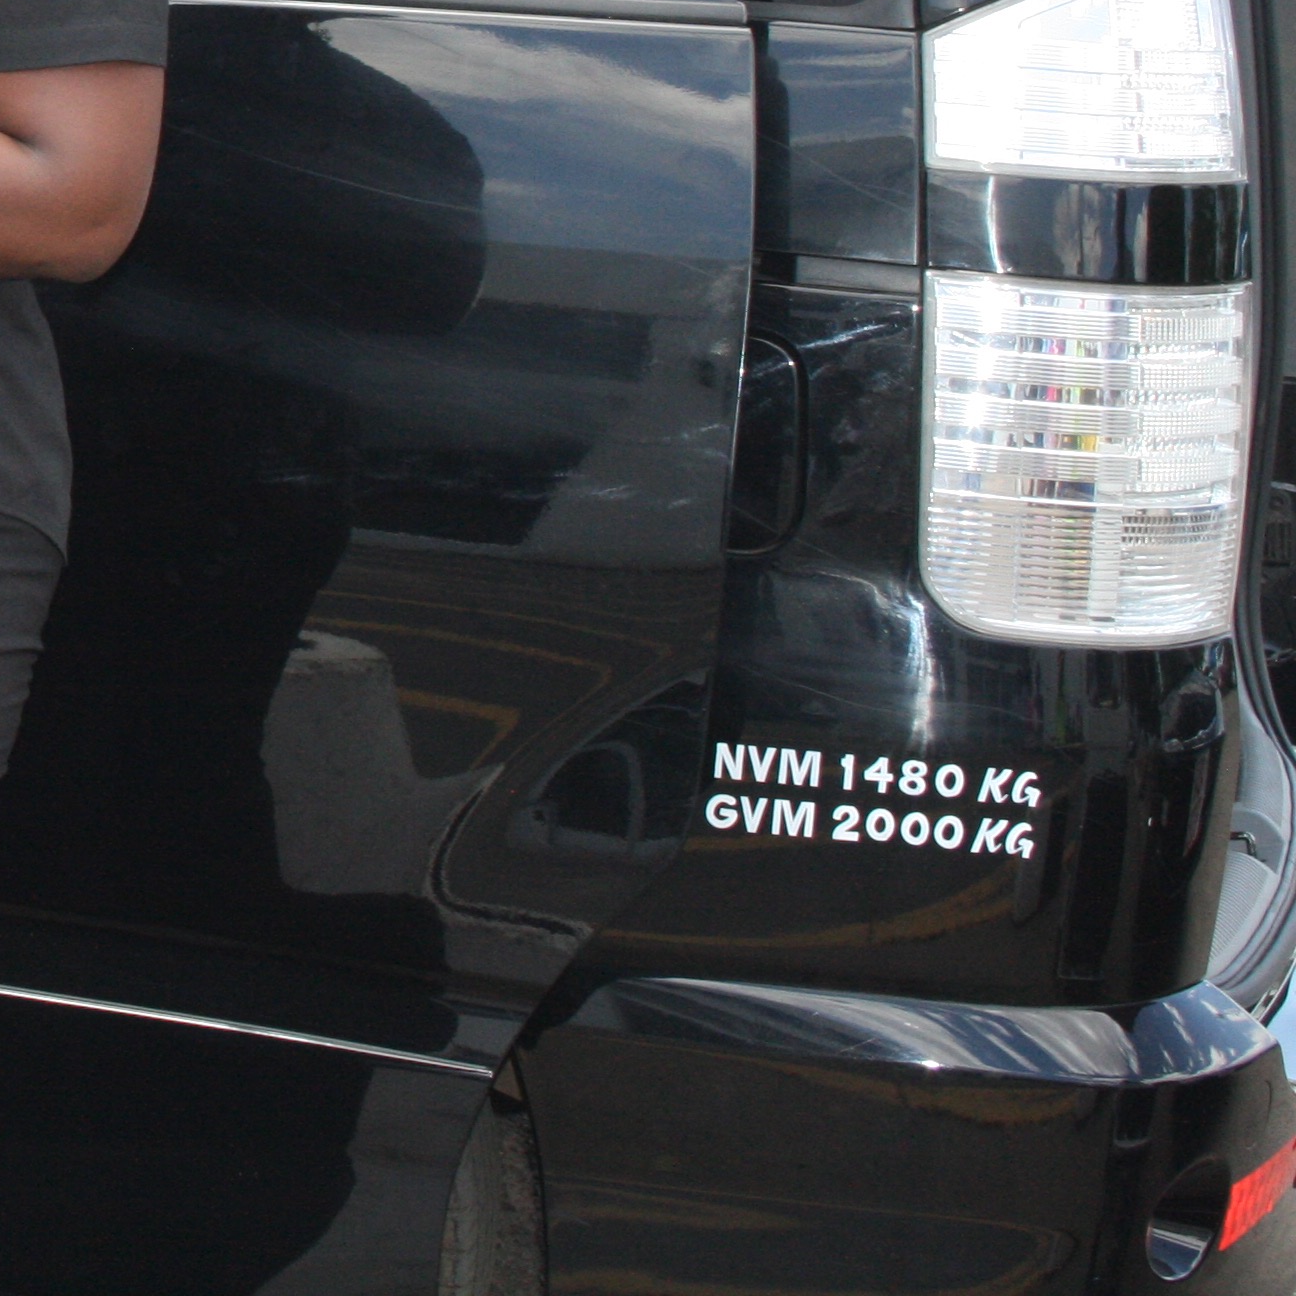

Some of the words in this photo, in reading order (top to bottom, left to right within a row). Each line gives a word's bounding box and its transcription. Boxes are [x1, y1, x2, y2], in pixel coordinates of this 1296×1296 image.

[713, 742, 822, 787] NVM
[840, 753, 965, 798] 1480
[977, 766, 1042, 807] KG
[705, 794, 816, 838] GVM
[832, 805, 965, 850] 2000
[970, 817, 1037, 859] KG
